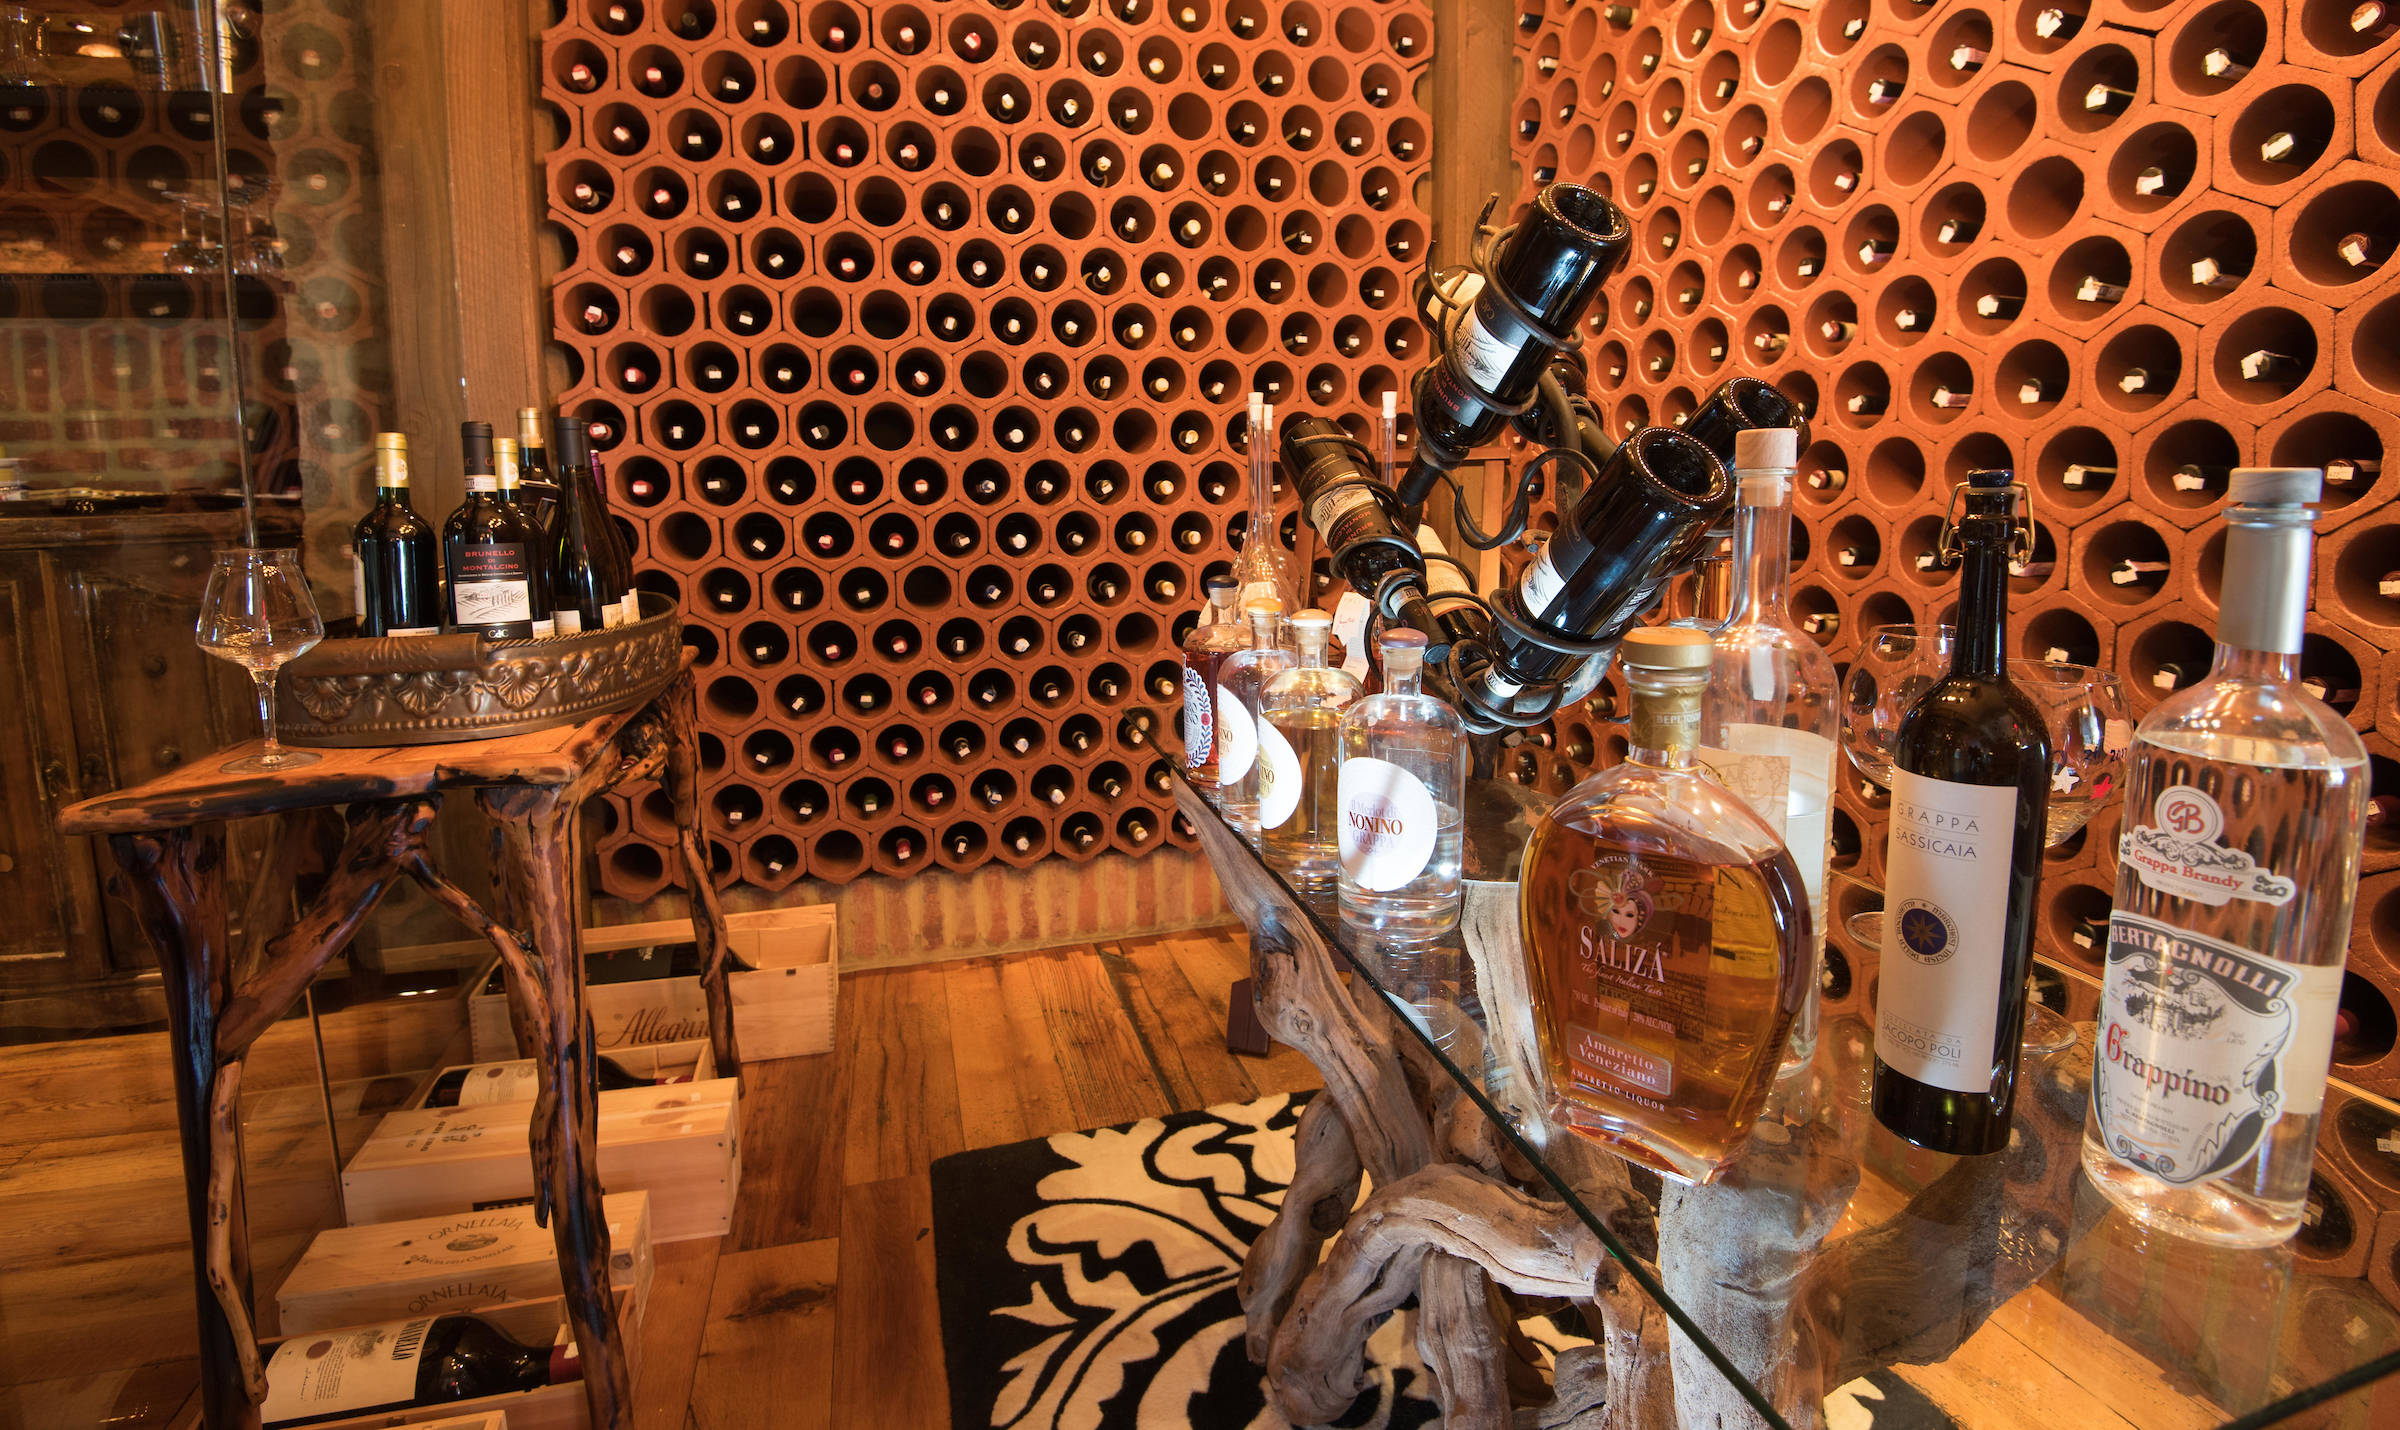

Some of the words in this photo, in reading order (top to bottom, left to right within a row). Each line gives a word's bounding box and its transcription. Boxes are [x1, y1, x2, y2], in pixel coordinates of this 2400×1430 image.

[1346, 521, 1374, 542] BRUNE
[462, 563, 519, 572] MONTALCINO
[464, 550, 515, 558] BRUNELLO
[1427, 577, 1458, 589] SCAVIN
[1656, 713, 1681, 724] BEPI
[1348, 811, 1403, 836] NONINO
[1357, 802, 1385, 818] Merlot
[1897, 802, 1979, 832] GRAPPA
[1352, 829, 1395, 849] GRAPPA
[1895, 827, 1977, 859] SASSICAIA
[1924, 827, 1935, 836] DI
[1590, 855, 1629, 870] VENETIAN
[1632, 858, 1655, 878] MASK
[2134, 849, 2178, 875] Grappa
[2182, 865, 2244, 891] Brandy
[1580, 925, 1666, 984] SALIZÁ
[2111, 924, 2282, 998] BERTAGNOLLI
[1581, 962, 1596, 974] The
[1616, 974, 1642, 991] Italian
[1644, 982, 1664, 998] Taste
[597, 1006, 710, 1048] Allegrin
[1882, 1020, 1926, 1050] JACOPO
[1929, 1042, 1961, 1059] POLI
[1946, 1037, 1961, 1045] DA
[1578, 1043, 1656, 1085] Veneziano
[1584, 1034, 1654, 1070] Amaretto
[2106, 1022, 2230, 1105] Grappino
[1571, 1068, 1621, 1095] AMARETTO
[1625, 1090, 1665, 1112] LIQUOR
[428, 1217, 523, 1241] ORNELLAIA
[408, 1283, 508, 1313] ORNELLAIA
